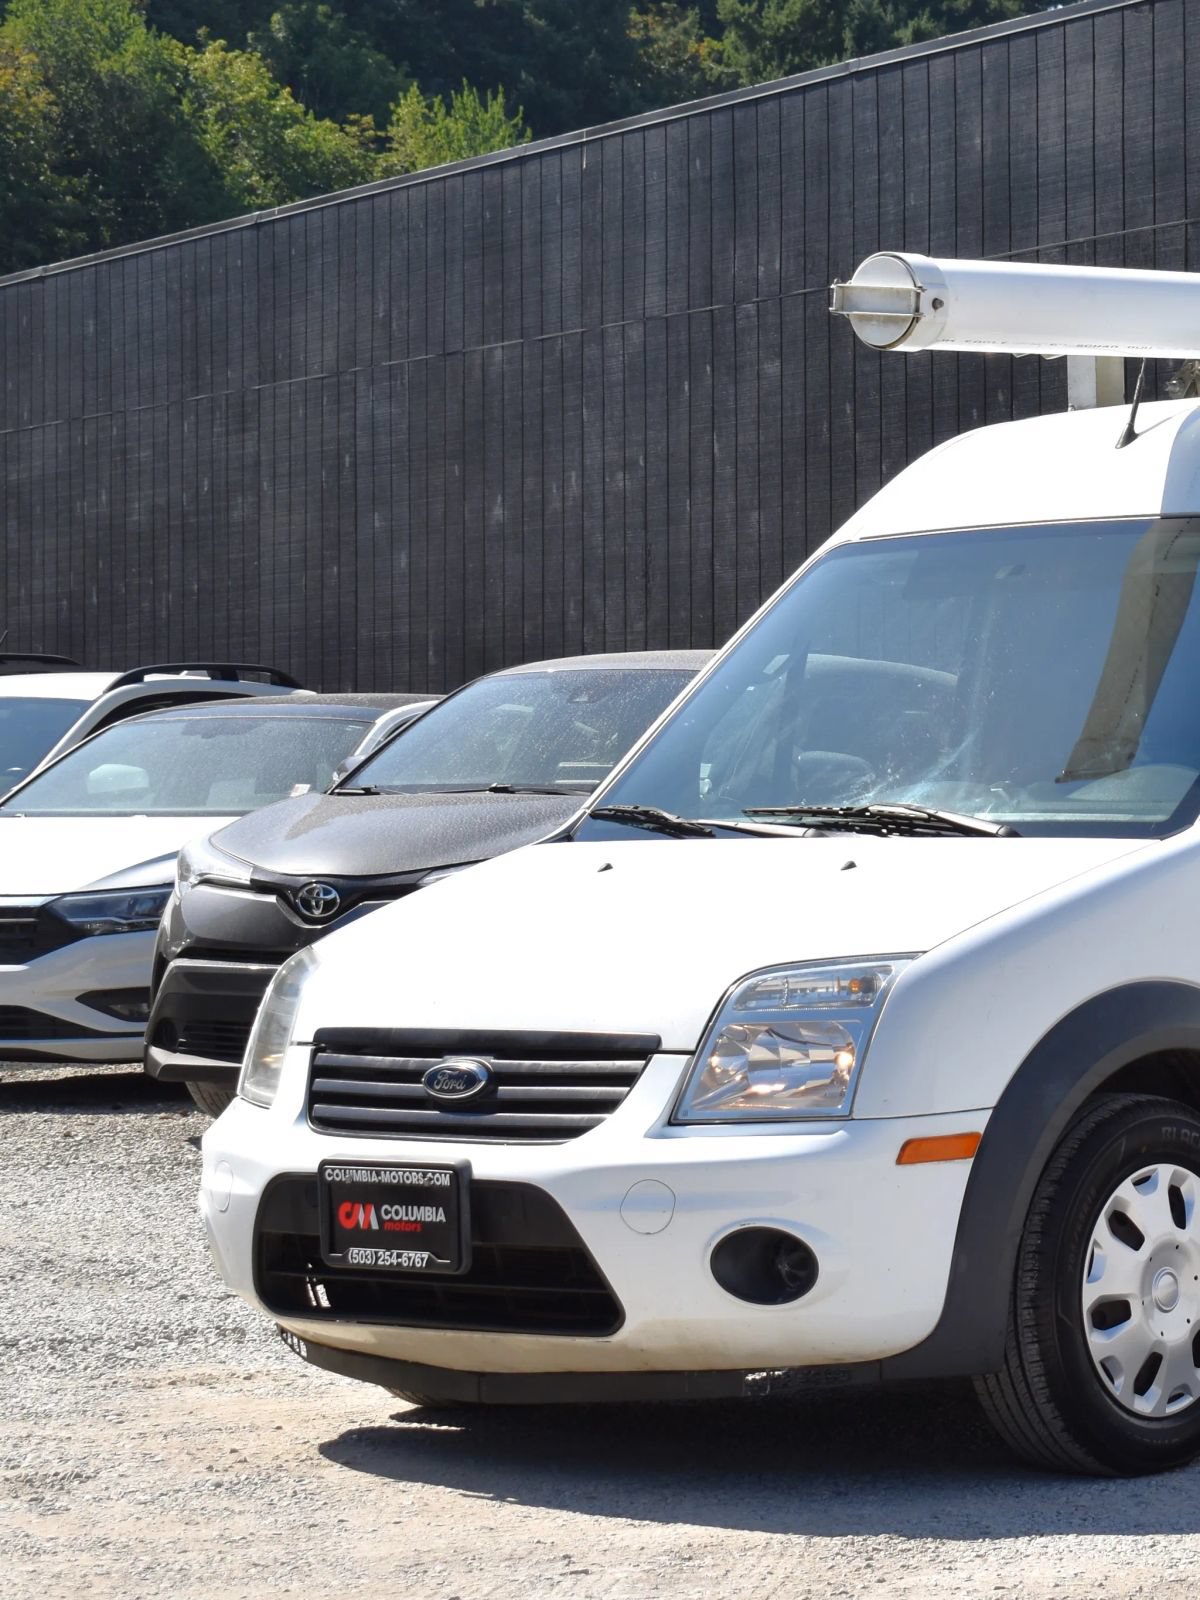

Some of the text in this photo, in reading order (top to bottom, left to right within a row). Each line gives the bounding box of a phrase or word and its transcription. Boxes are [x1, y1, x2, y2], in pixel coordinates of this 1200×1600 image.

[433, 1069, 468, 1090] Ford
[325, 1168, 450, 1186] COLUMBIA-MOTORSCOM
[381, 1204, 446, 1222] COLUMBIA
[384, 1221, 422, 1232] motors
[348, 1249, 429, 1267] (503) 254-6767
